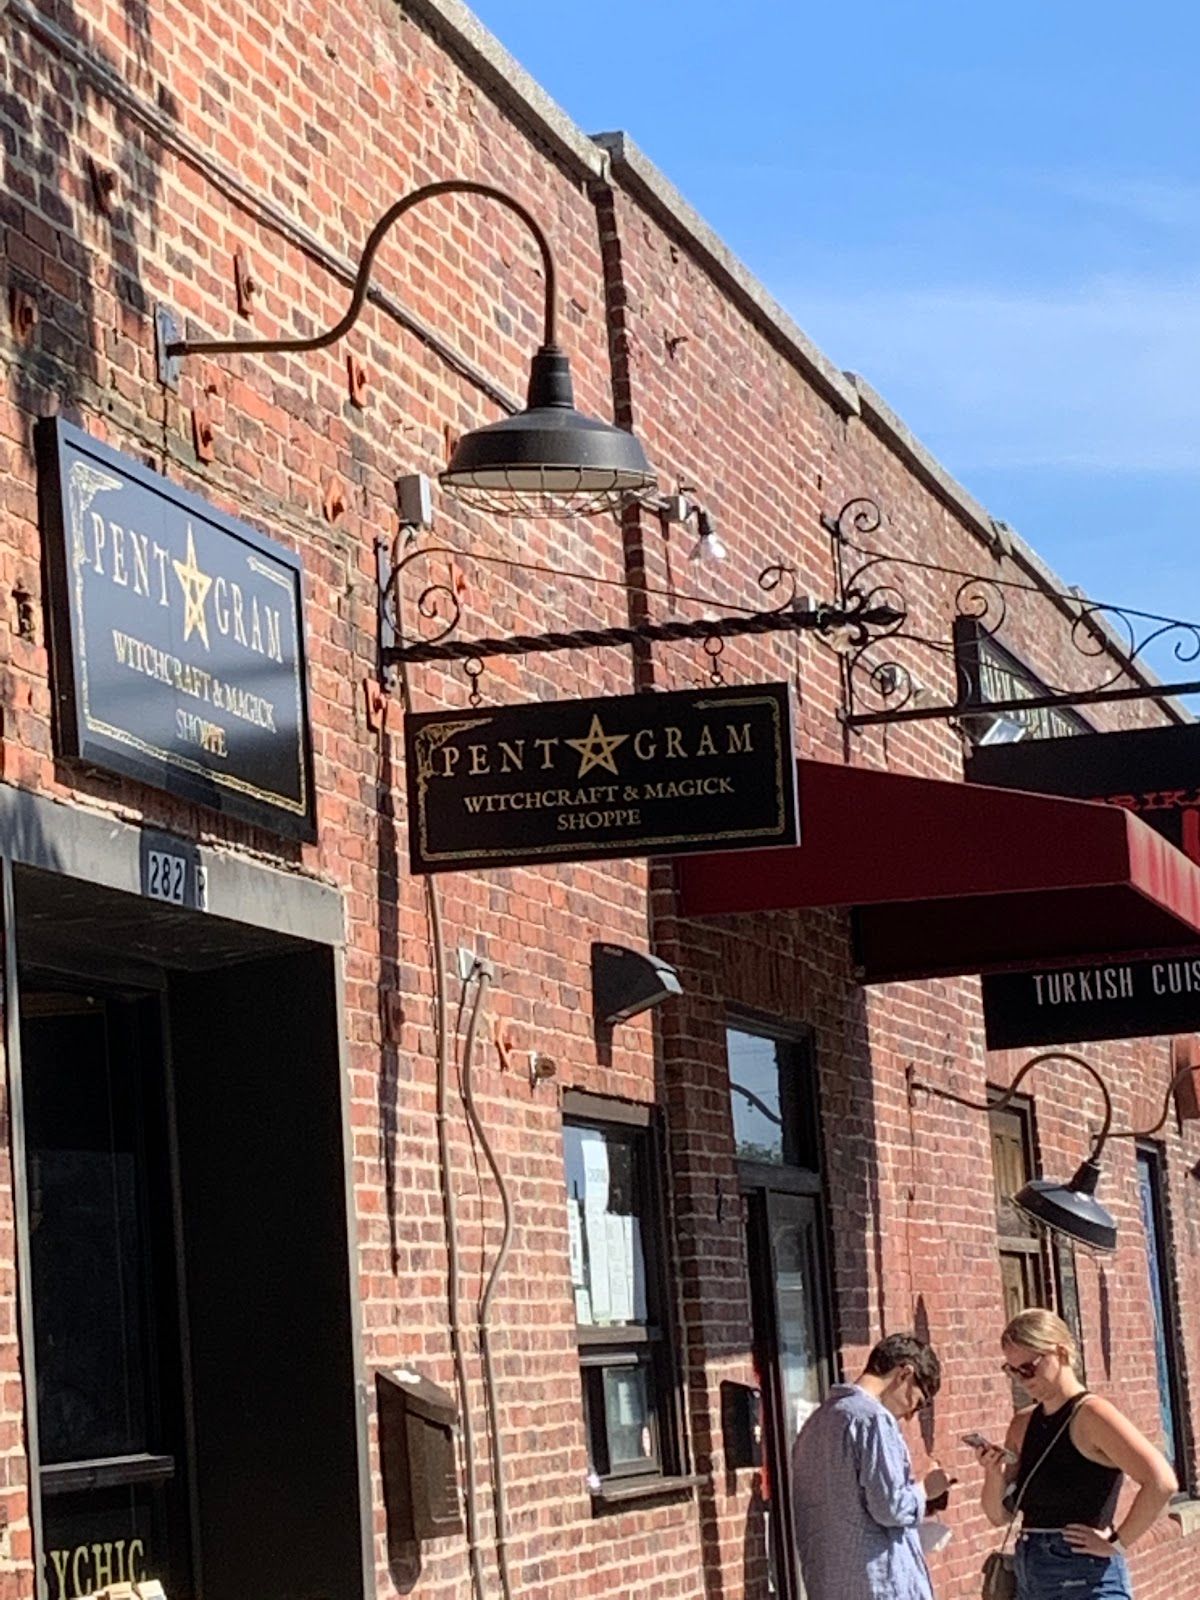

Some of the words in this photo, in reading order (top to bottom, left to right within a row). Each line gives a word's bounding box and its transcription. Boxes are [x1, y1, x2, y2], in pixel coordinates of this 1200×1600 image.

[112, 629, 212, 702] WITCHCRAFT
[213, 679, 225, 708] &
[224, 682, 277, 734] MAGICK
[175, 708, 228, 758] SHOPPE
[463, 785, 618, 814] WITCHCRAFT
[622, 786, 640, 800] &
[644, 776, 735, 798] MAGICK
[556, 808, 642, 831] SHOPPE
[150, 855, 183, 900] 282
[1033, 966, 1134, 1005] TURKISH
